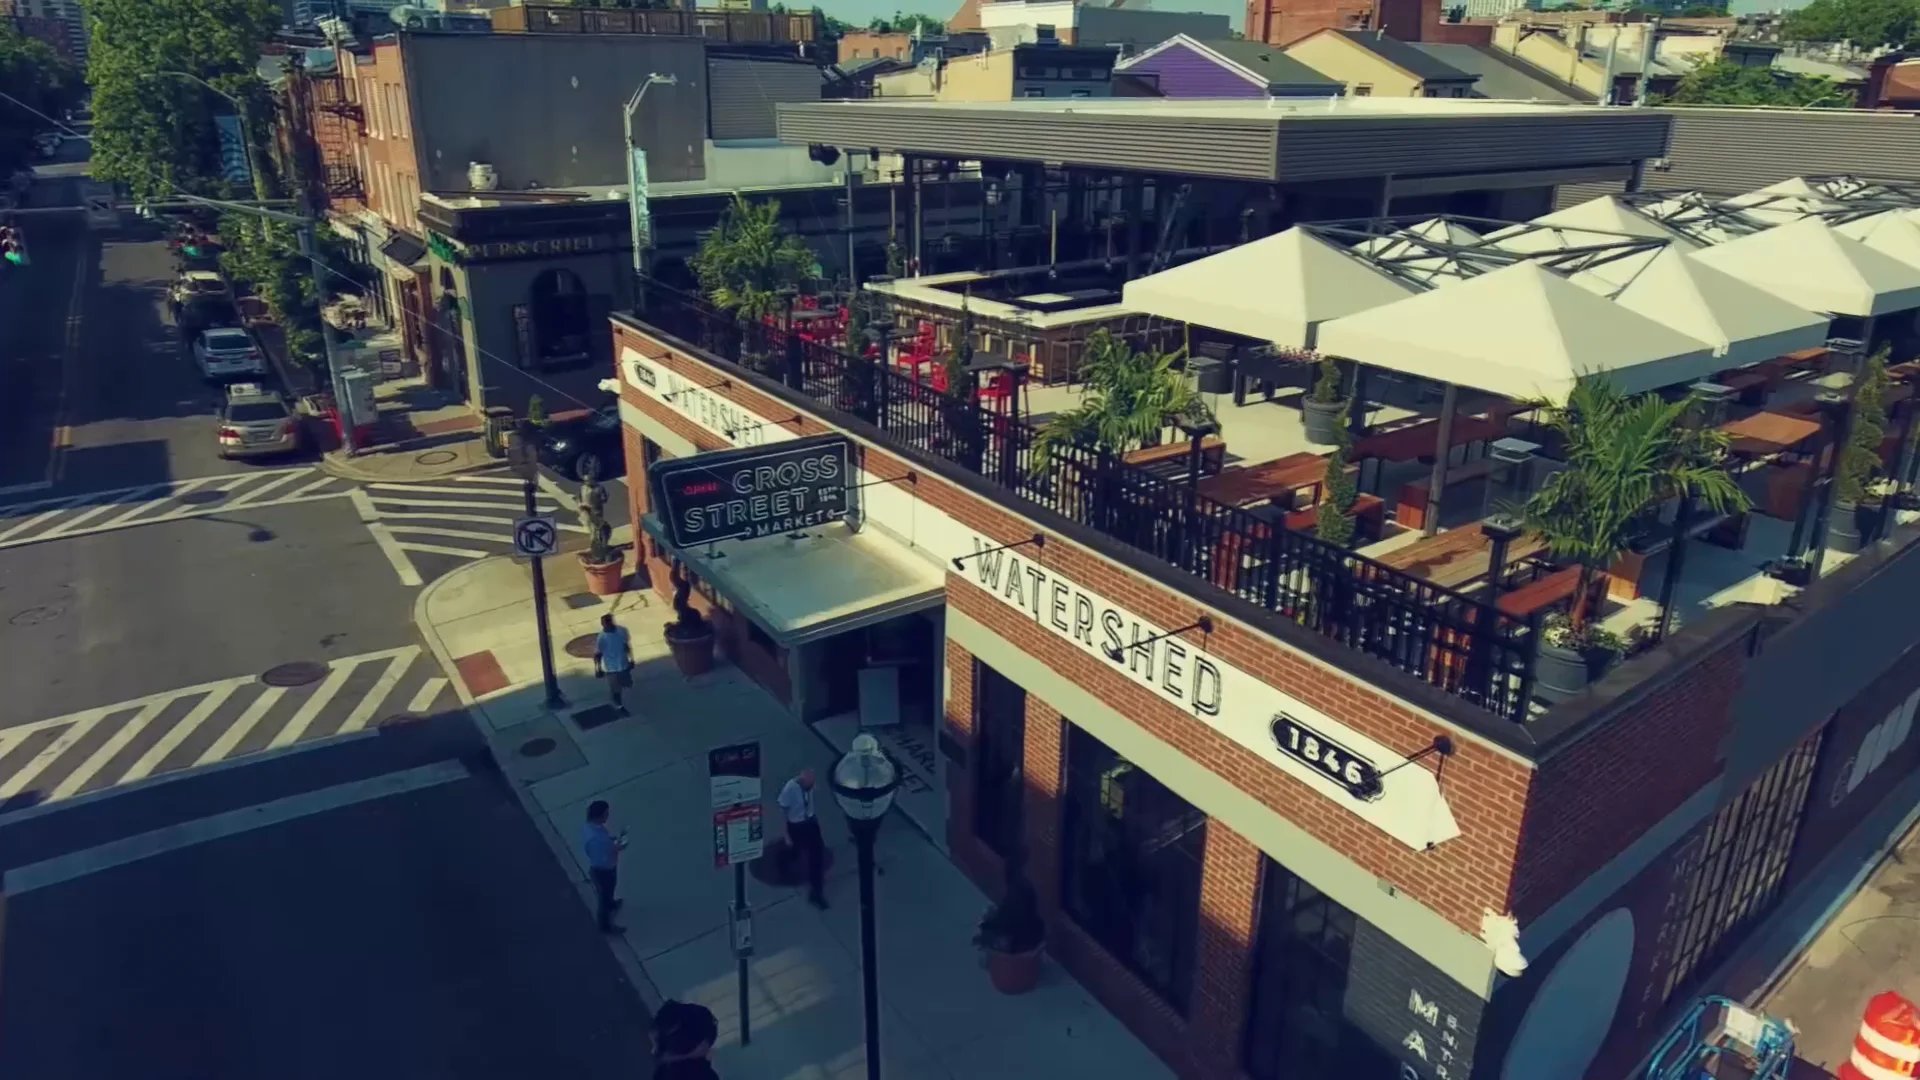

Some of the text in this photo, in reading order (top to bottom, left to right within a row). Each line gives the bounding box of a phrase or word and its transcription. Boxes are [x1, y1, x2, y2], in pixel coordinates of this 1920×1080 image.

[732, 455, 838, 494] CROSS
[684, 487, 809, 532] STREET
[756, 510, 823, 537] MARKET
[973, 536, 1222, 716] WATERSHED
[1287, 726, 1363, 784] 1846
